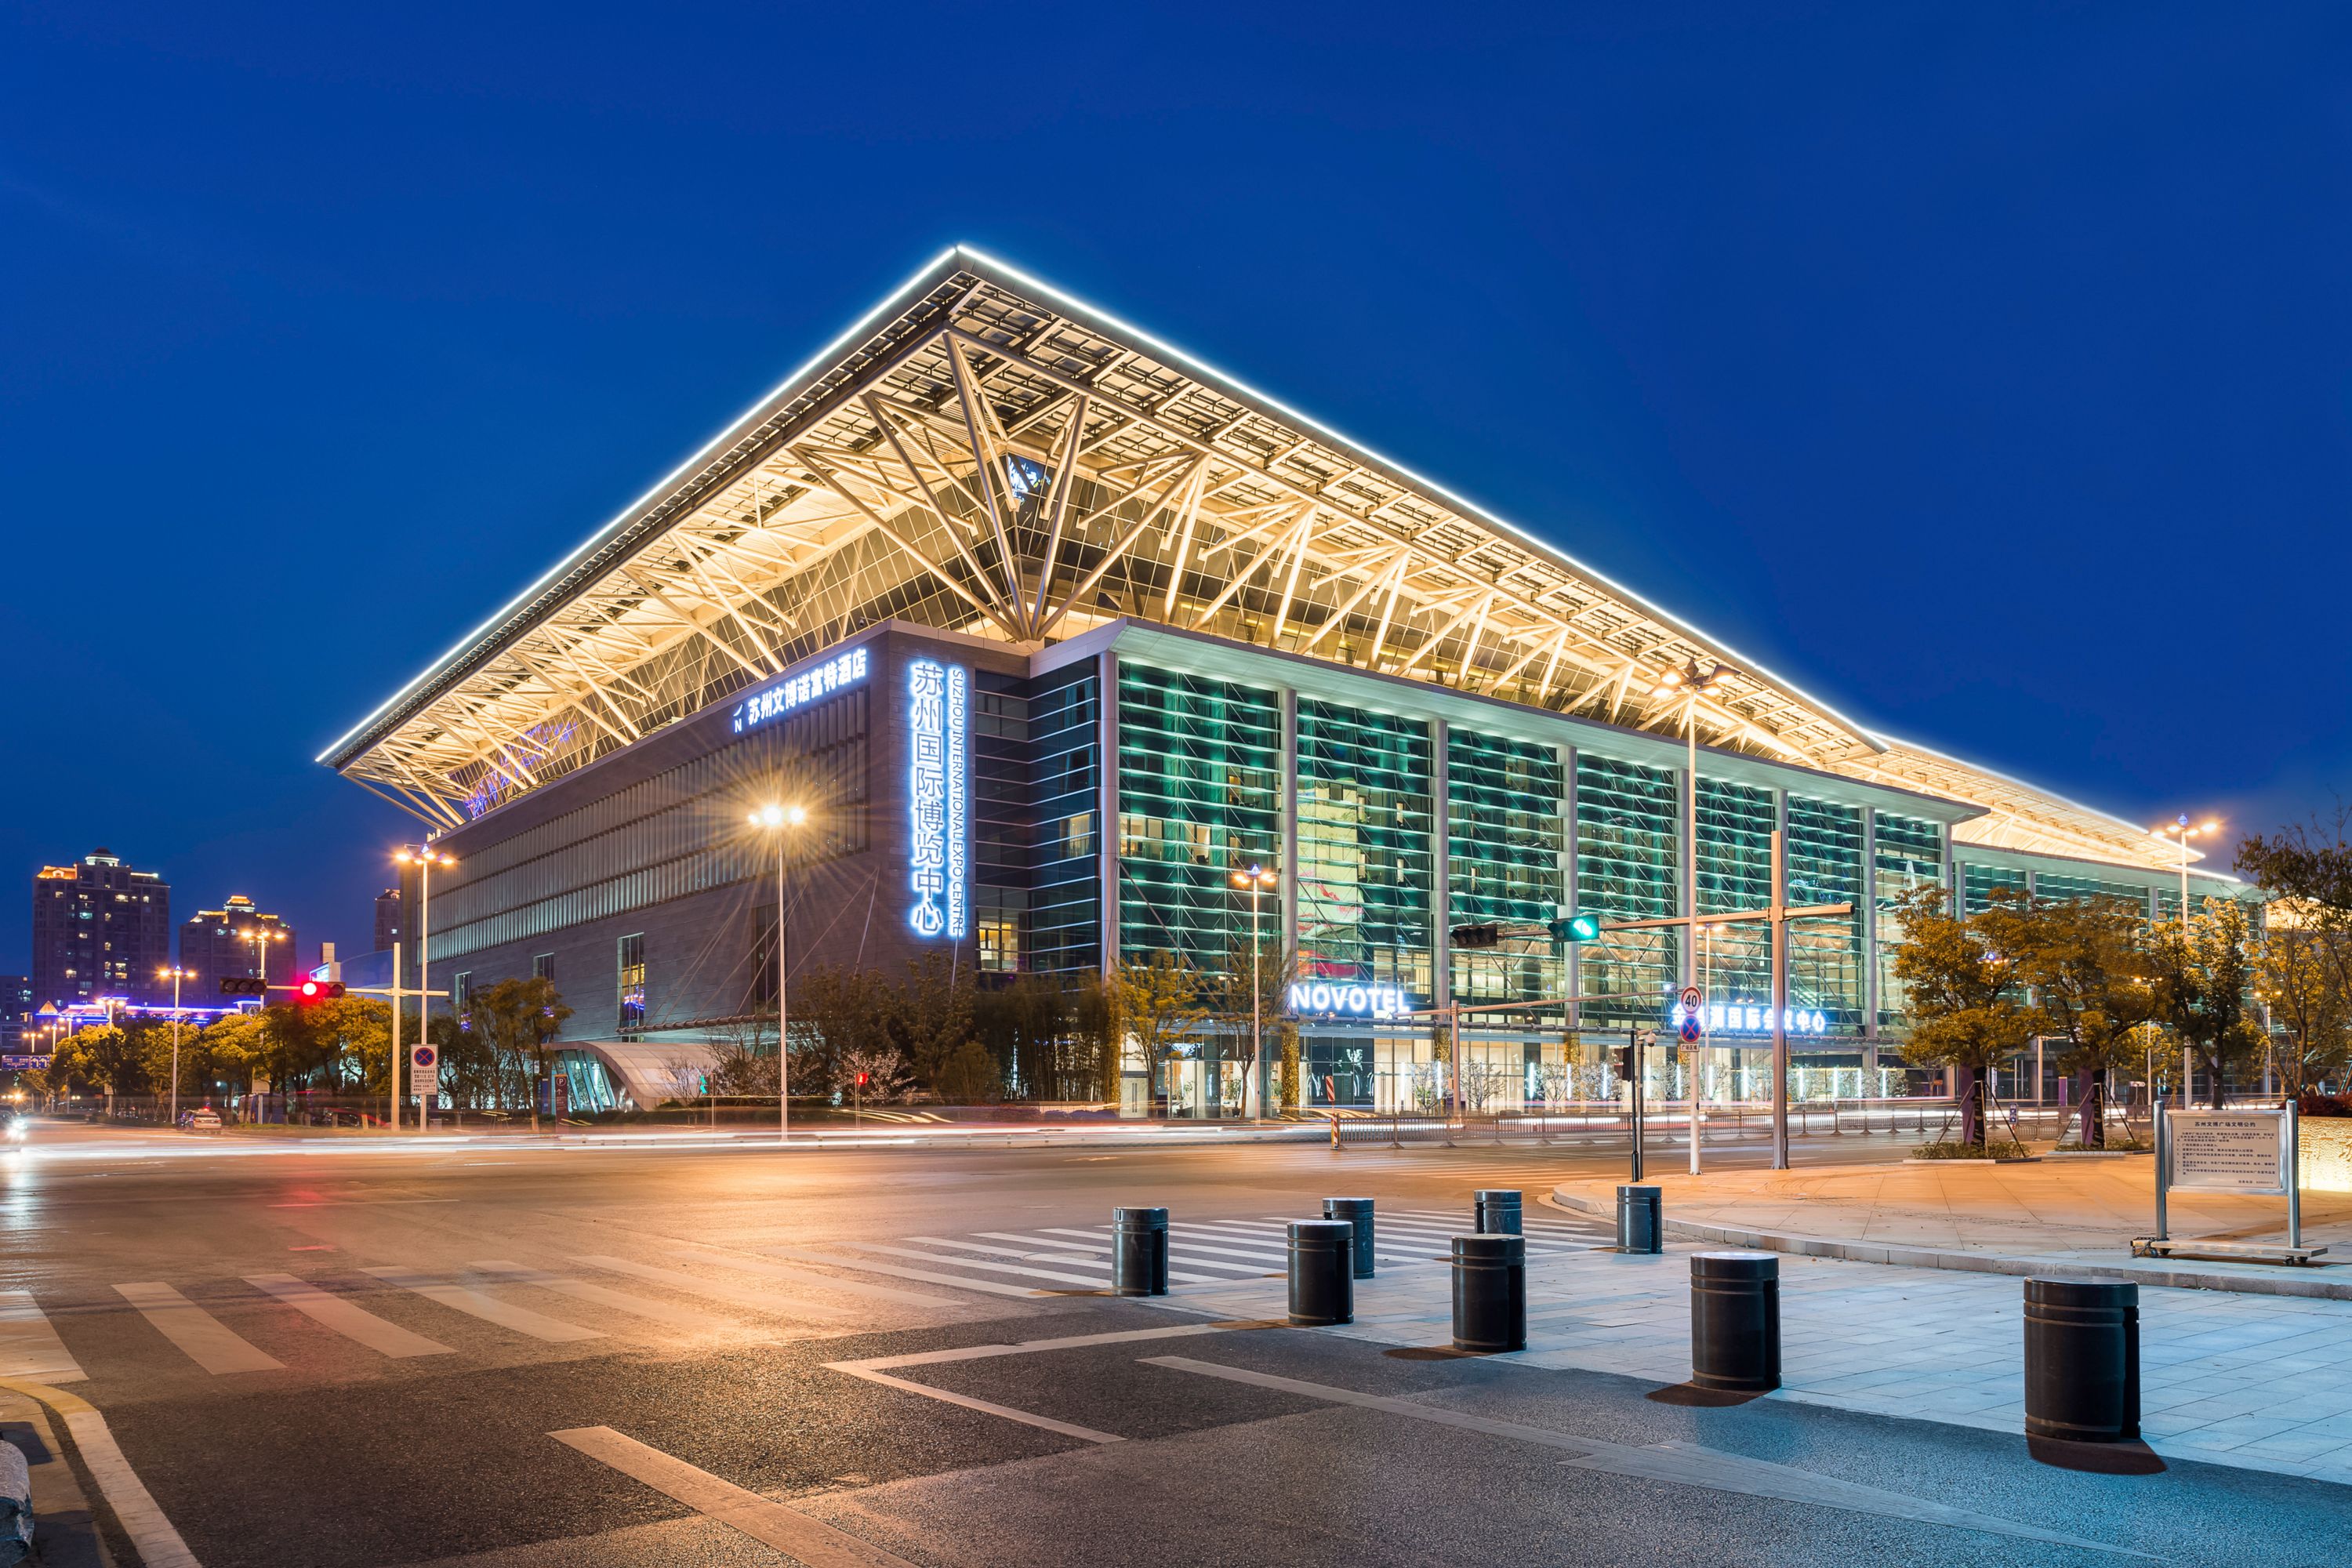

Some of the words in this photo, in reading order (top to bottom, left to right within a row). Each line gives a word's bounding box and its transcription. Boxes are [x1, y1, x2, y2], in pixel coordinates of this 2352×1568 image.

[747, 648, 867, 726] 苏州文博诺富特酒店
[953, 670, 964, 728] SUZHOU
[734, 718, 742, 733] N
[915, 664, 943, 932] 苏州国际博览中心
[953, 731, 964, 838] INTERNATIONAL
[953, 843, 964, 877] EXPO
[953, 881, 964, 934] CENTRE
[1291, 985, 1410, 1012] NOVOTEL
[1685, 994, 1697, 1007] 40
